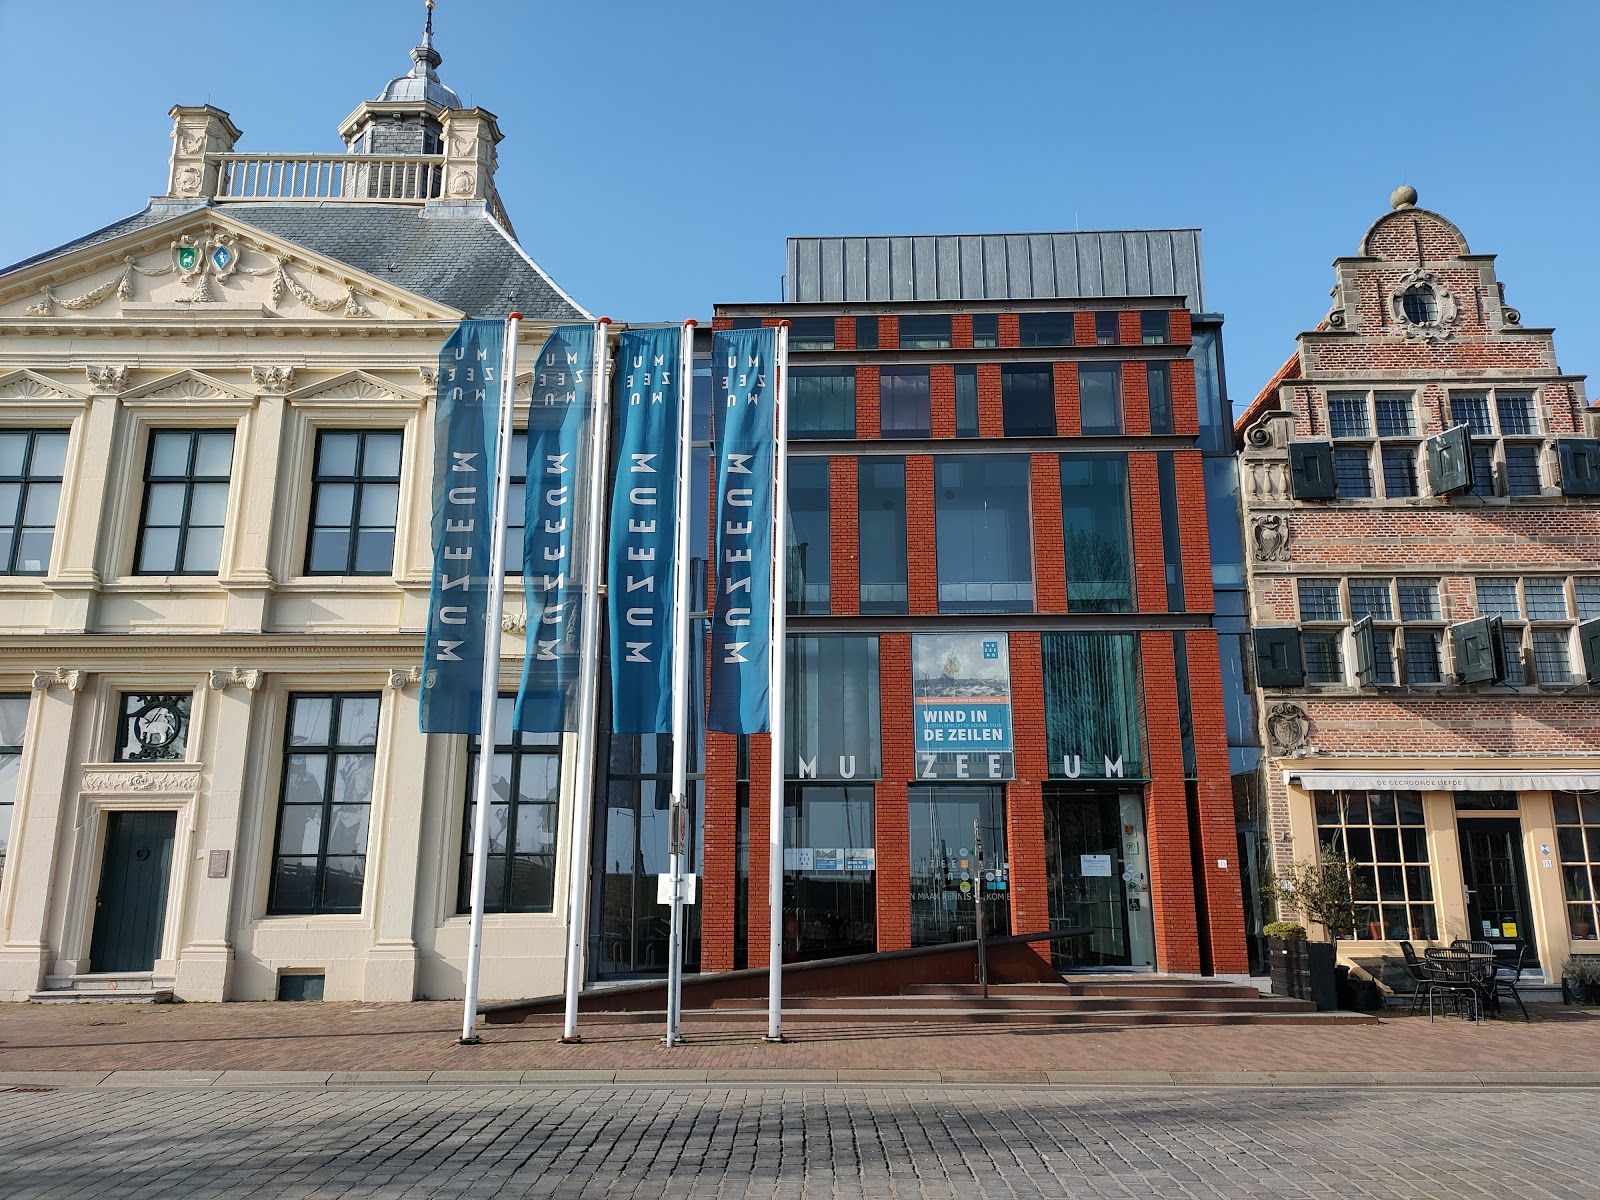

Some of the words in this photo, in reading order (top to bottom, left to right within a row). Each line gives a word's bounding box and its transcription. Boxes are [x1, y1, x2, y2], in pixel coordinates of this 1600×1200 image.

[923, 710, 966, 723] WIND
[971, 710, 988, 723] IN
[924, 728, 944, 742] DE
[948, 728, 1003, 741] ZEILEN
[942, 892, 972, 901] KENNIS
[986, 892, 1005, 900] KOM
